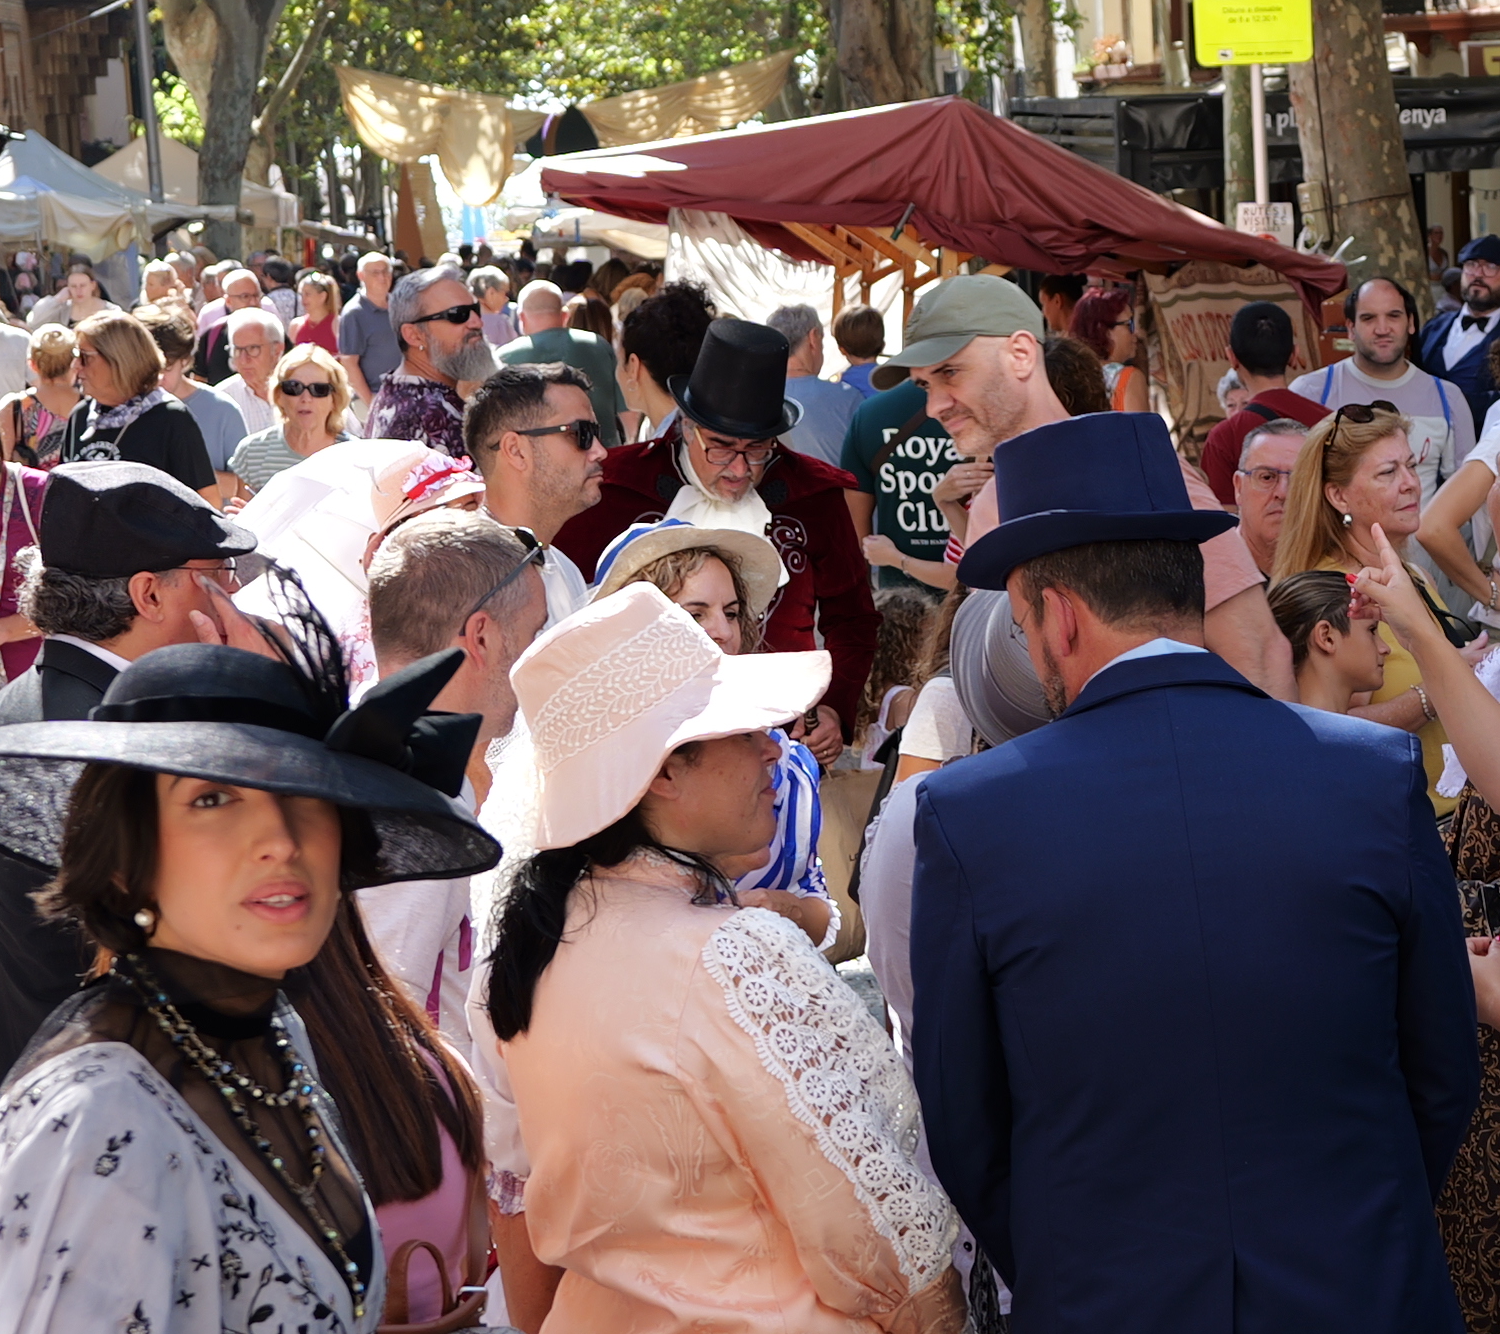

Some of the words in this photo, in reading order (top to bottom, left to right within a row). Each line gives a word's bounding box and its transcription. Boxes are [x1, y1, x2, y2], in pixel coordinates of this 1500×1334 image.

[1243, 206, 1279, 216] RUTES
[1243, 216, 1286, 226] VISITES
[879, 463, 946, 501] Spo
